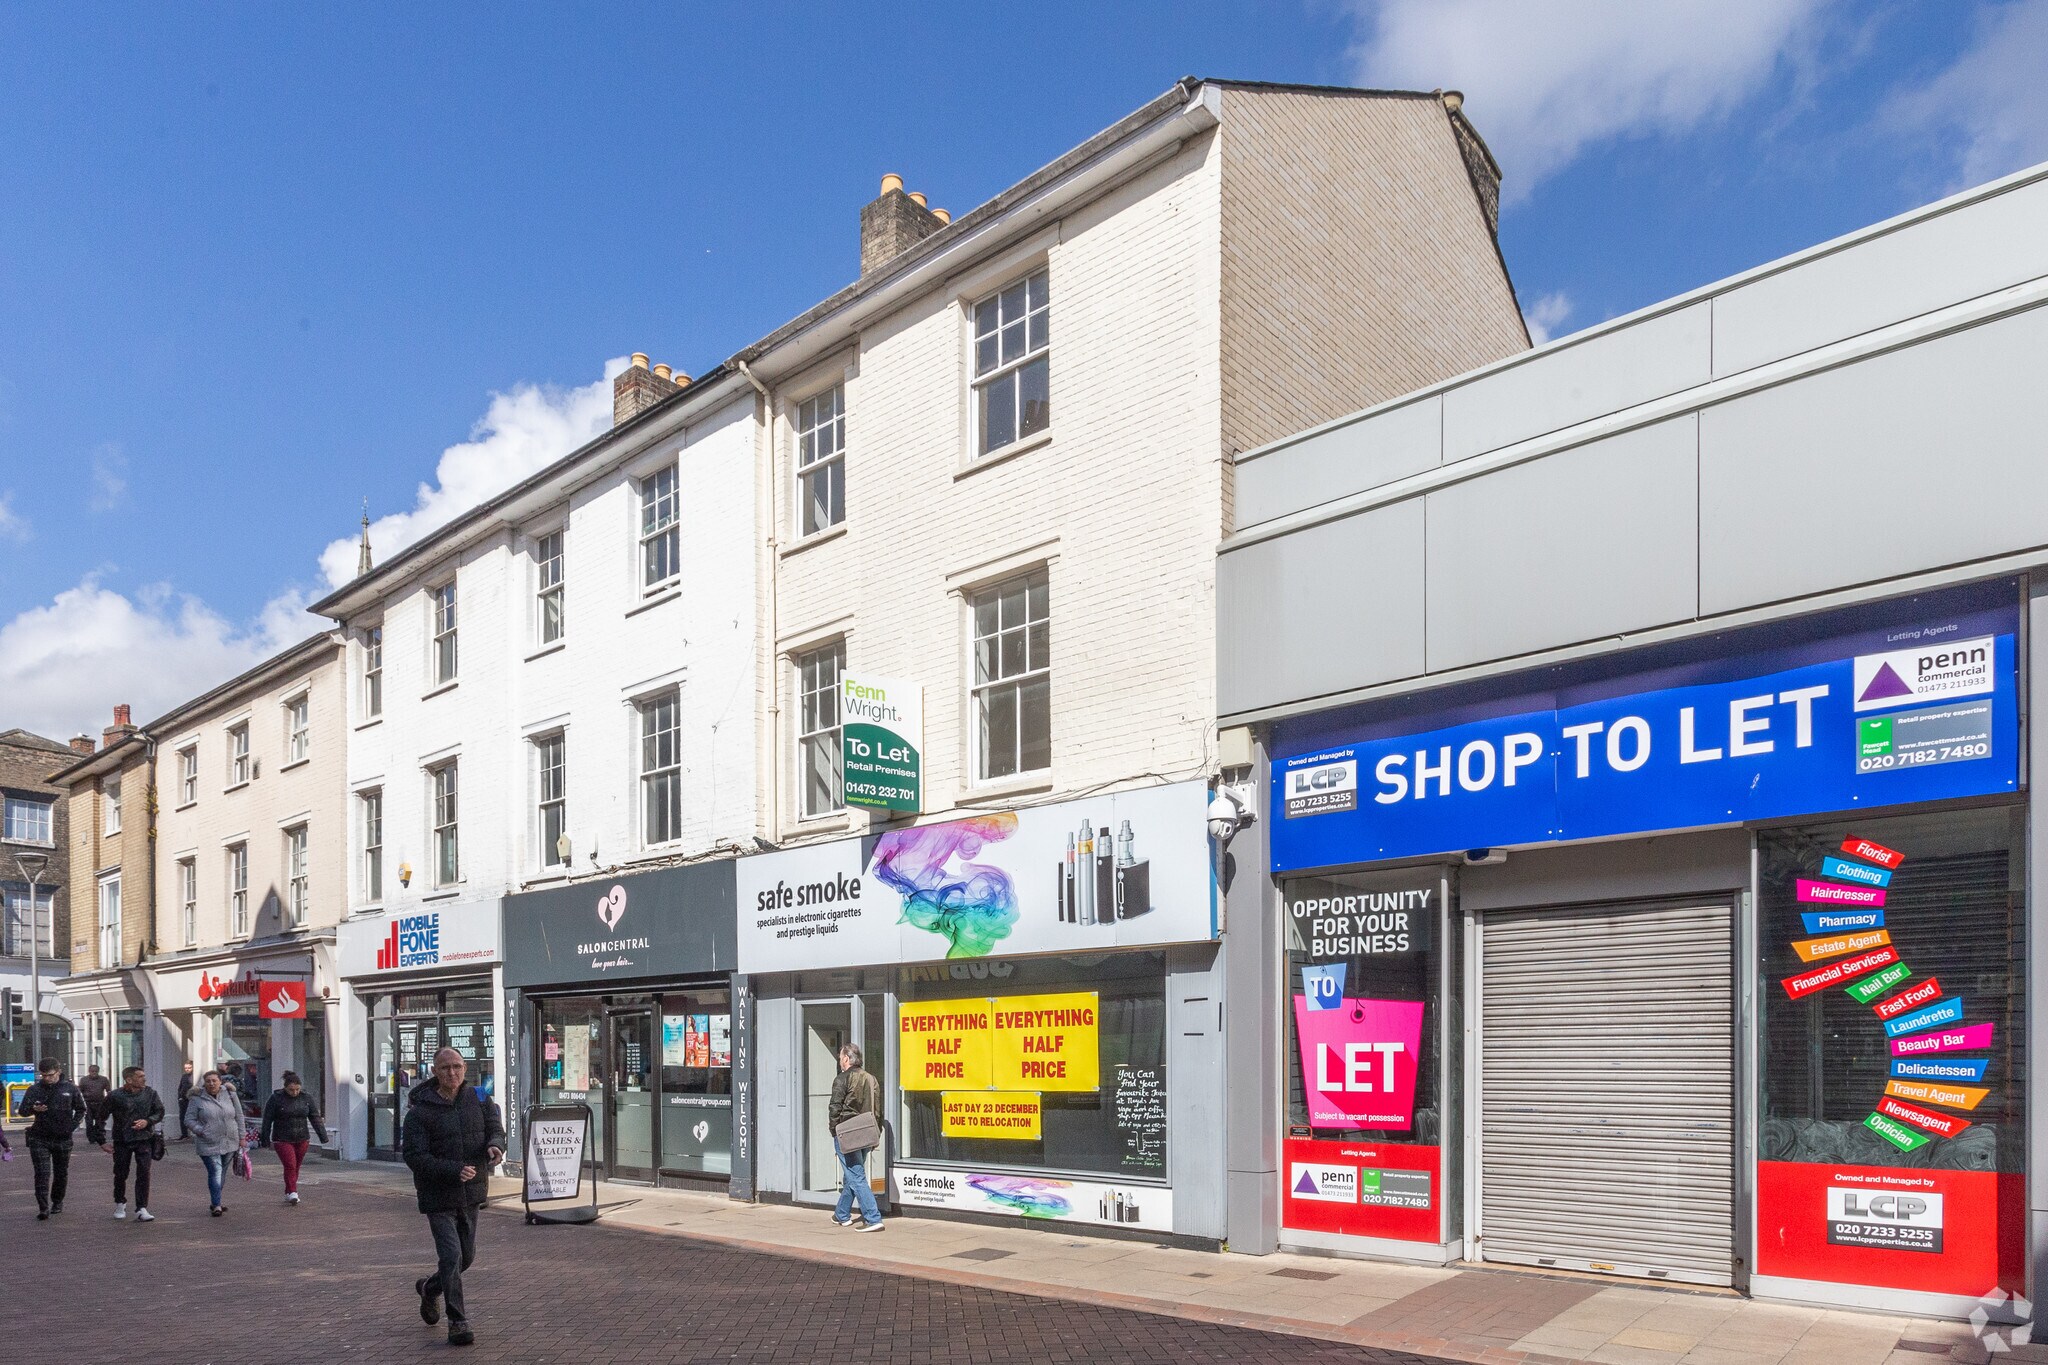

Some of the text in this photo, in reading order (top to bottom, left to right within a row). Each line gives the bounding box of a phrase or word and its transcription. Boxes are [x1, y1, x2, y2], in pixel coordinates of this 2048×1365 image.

[1887, 623, 1958, 642] Letting Agents
[1918, 647, 1986, 676] penn
[1918, 664, 1986, 683] commercial
[845, 679, 886, 702] Fenn
[1917, 676, 1986, 694] 01473 211933
[1898, 706, 1988, 724] Retail property expertise
[847, 737, 910, 763] To Let
[1374, 684, 1830, 804] SHOP TO LET
[1862, 740, 1889, 749] Fawcett
[1898, 732, 1988, 750] www.fawcettmead.co.uk
[1288, 749, 1354, 767] Owned and Managed by
[1860, 742, 1988, 770] 020 7182 7480
[1862, 747, 1882, 755] Mead
[846, 760, 917, 778] Retail Premises
[1296, 767, 1347, 793] LCP
[846, 782, 915, 801] 01473 232 701
[846, 795, 888, 806] fennwright.co.uk
[1290, 792, 1352, 809] 020 7233 5255
[1290, 802, 1352, 815] www.lcpproperties.co.uk
[1856, 842, 1893, 864] Florist
[1836, 863, 1882, 885] Clothing
[757, 872, 861, 912] safe smoke
[1810, 886, 1876, 902] Hairdresser
[1293, 889, 1431, 918] OPPORTUNITY
[400, 913, 439, 932] MOBILE
[756, 908, 862, 930] specialists in electronic cigarettes
[1312, 912, 1409, 936] FOR YOUR
[1819, 913, 1876, 928] Pharmacy
[776, 923, 839, 939] and prestige liquids
[400, 929, 439, 953] FONE
[1312, 934, 1410, 957] BUSINESS
[1810, 932, 1882, 956] Estate Agent
[400, 951, 439, 967] EXPERTS
[441, 949, 495, 962] mobilefoneexperts.com
[591, 957, 603, 969] love
[602, 961, 616, 971] your
[1792, 950, 1891, 992] Financial Services
[1310, 976, 1336, 997] TO
[1859, 967, 1903, 997] Nail Bar
[738, 987, 748, 1030] WALK
[1879, 984, 1935, 1017] Fast Food
[508, 1000, 516, 1035] WALK
[901, 1013, 988, 1033] EVERYTHING
[995, 1008, 1094, 1030] EVERYTHING
[1890, 1006, 1955, 1034] Laundrette
[927, 1038, 962, 1055] HALF
[1023, 1035, 1064, 1053] HALF
[1897, 1033, 1965, 1053] Beauty Bar
[925, 1062, 964, 1079] PRICE
[1021, 1061, 1066, 1079] PRICE
[1117, 1069, 1154, 1081] You Can
[1316, 1042, 1405, 1093] LET
[1897, 1062, 1976, 1077] Delicatessen
[671, 1096, 731, 1107] saloncentralgroup.com
[1893, 1082, 1965, 1104] Travel Agent
[509, 1075, 517, 1138] WELCOME
[943, 1103, 1039, 1114] LAST DAY 23 DECEMBER
[738, 1081, 748, 1159] WELCOME
[950, 1117, 1031, 1128] DUE TO RELOCATION
[1314, 1111, 1405, 1123] Subject to vacant possession
[1884, 1101, 1952, 1132] Newsagent
[542, 1126, 575, 1135] NAILS,
[1869, 1115, 1913, 1147] Optician
[533, 1136, 572, 1146] LASHES
[536, 1147, 576, 1156] BEAUTY
[1341, 1149, 1358, 1157] Letting
[528, 1177, 576, 1187] APPOINTMENTS
[903, 1173, 955, 1190] safe smoke
[1321, 1171, 1353, 1183] penn
[1835, 1173, 1935, 1187] Owned and Managed by
[534, 1186, 567, 1195] AVAILABLE
[1363, 1194, 1429, 1207] 020 7182 7480
[1844, 1194, 1926, 1220] LCP
[1836, 1224, 1933, 1240] 020 7233 5255
[1836, 1235, 1933, 1248] www.lcpproperties.co.uk
